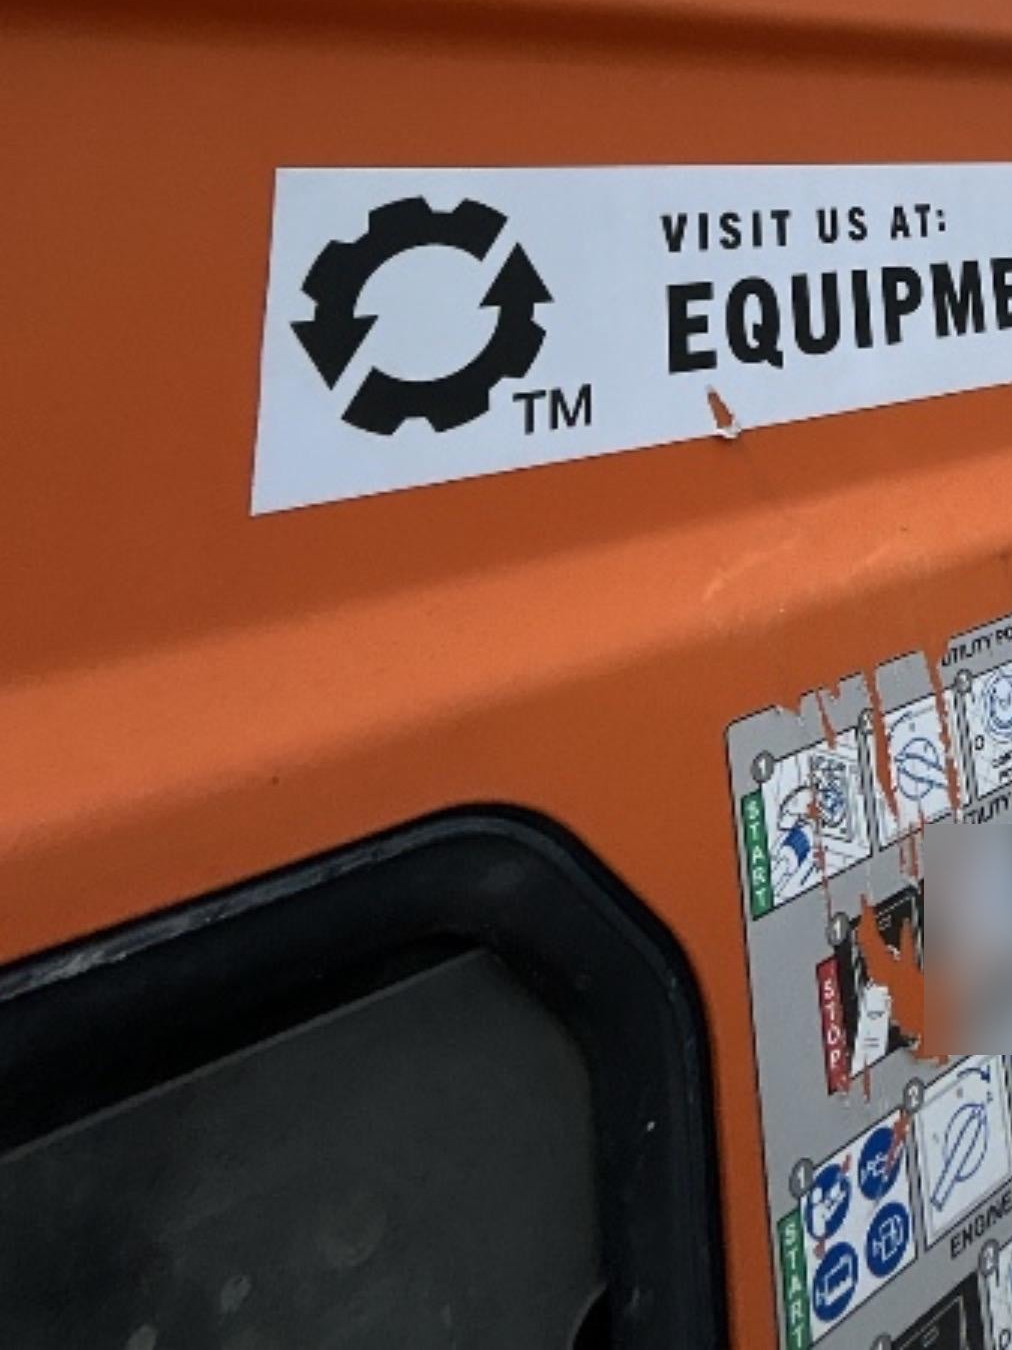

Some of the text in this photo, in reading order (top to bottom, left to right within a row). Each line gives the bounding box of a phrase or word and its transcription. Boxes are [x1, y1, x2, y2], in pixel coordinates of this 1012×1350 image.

[661, 203, 946, 252] VISIT US AT:
[512, 383, 592, 434] TM
[746, 800, 768, 908] START
[823, 979, 842, 1069] STOP
[783, 1223, 806, 1350] START
